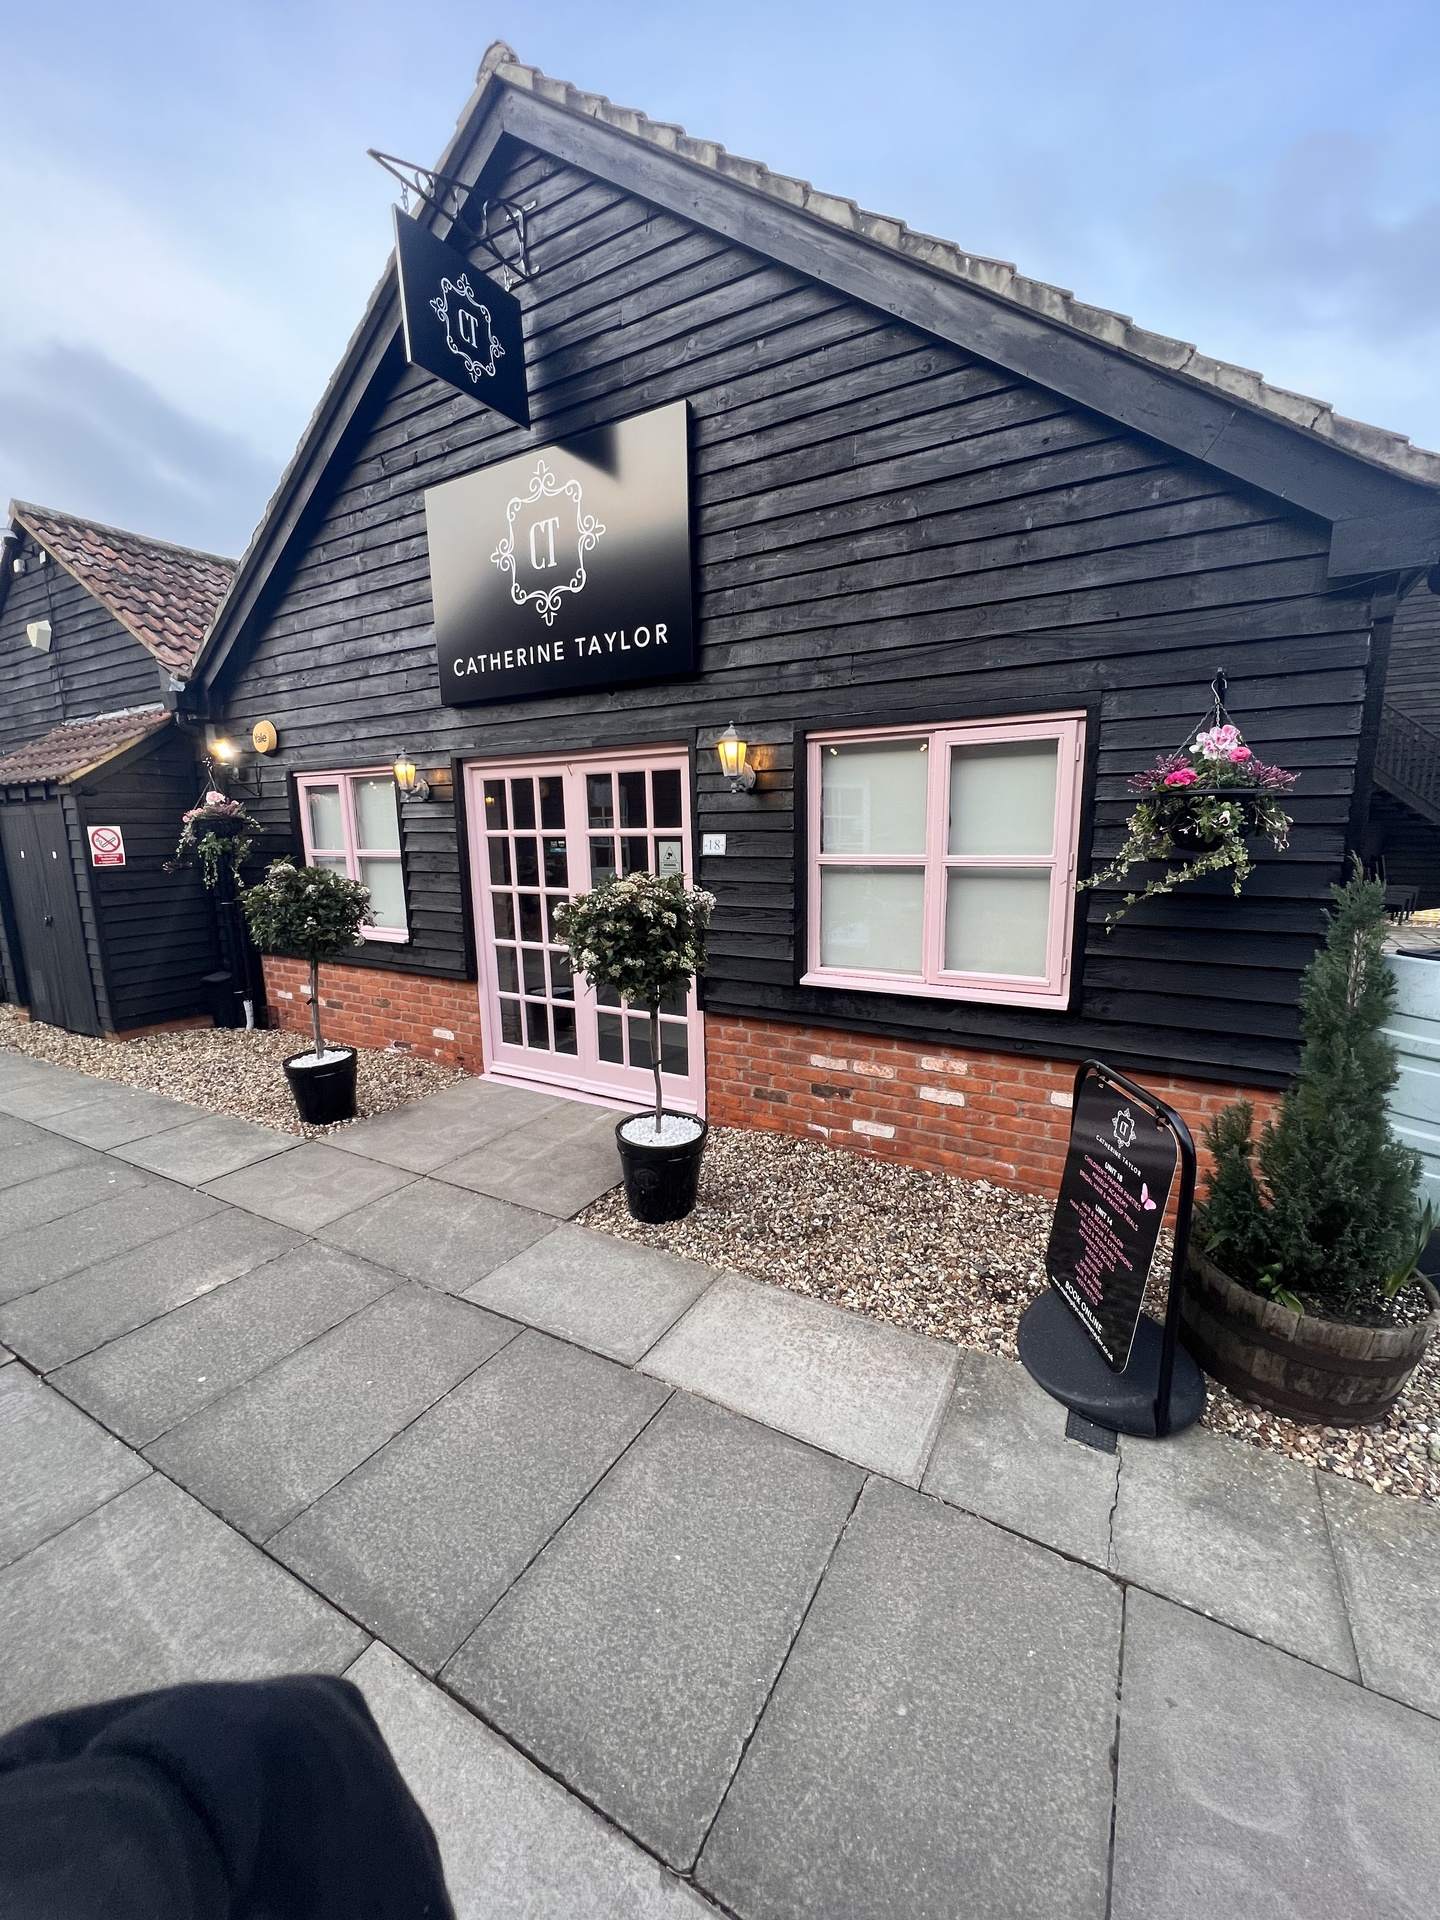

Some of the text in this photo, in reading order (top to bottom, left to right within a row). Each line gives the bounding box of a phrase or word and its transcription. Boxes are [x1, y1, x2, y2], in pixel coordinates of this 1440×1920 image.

[458, 308, 479, 349] CT
[529, 516, 560, 570] CT
[453, 623, 668, 677] CATHERINE TAYLOR
[709, 839, 720, 850] 18
[1096, 1135, 1141, 1177] CATHERINE TAYLOR
[1105, 1162, 1117, 1176] UNIT
[1093, 1183, 1103, 1195] HAIR
[1107, 1196, 1124, 1214] MAKEUP
[1124, 1213, 1138, 1231] TRIALS
[1107, 1175, 1123, 1193] PAMPER
[1124, 1191, 1141, 1211] PARTIES
[1108, 1188, 1128, 1208] ACADEMY
[1095, 1204, 1113, 1226] UNIT 14
[1088, 1218, 1104, 1237] COLOUR
[1107, 1239, 1133, 1271] EXTENSIONS
[1110, 1231, 1123, 1249] SALON
[1065, 1281, 1103, 1334] BOOK ONLINE
